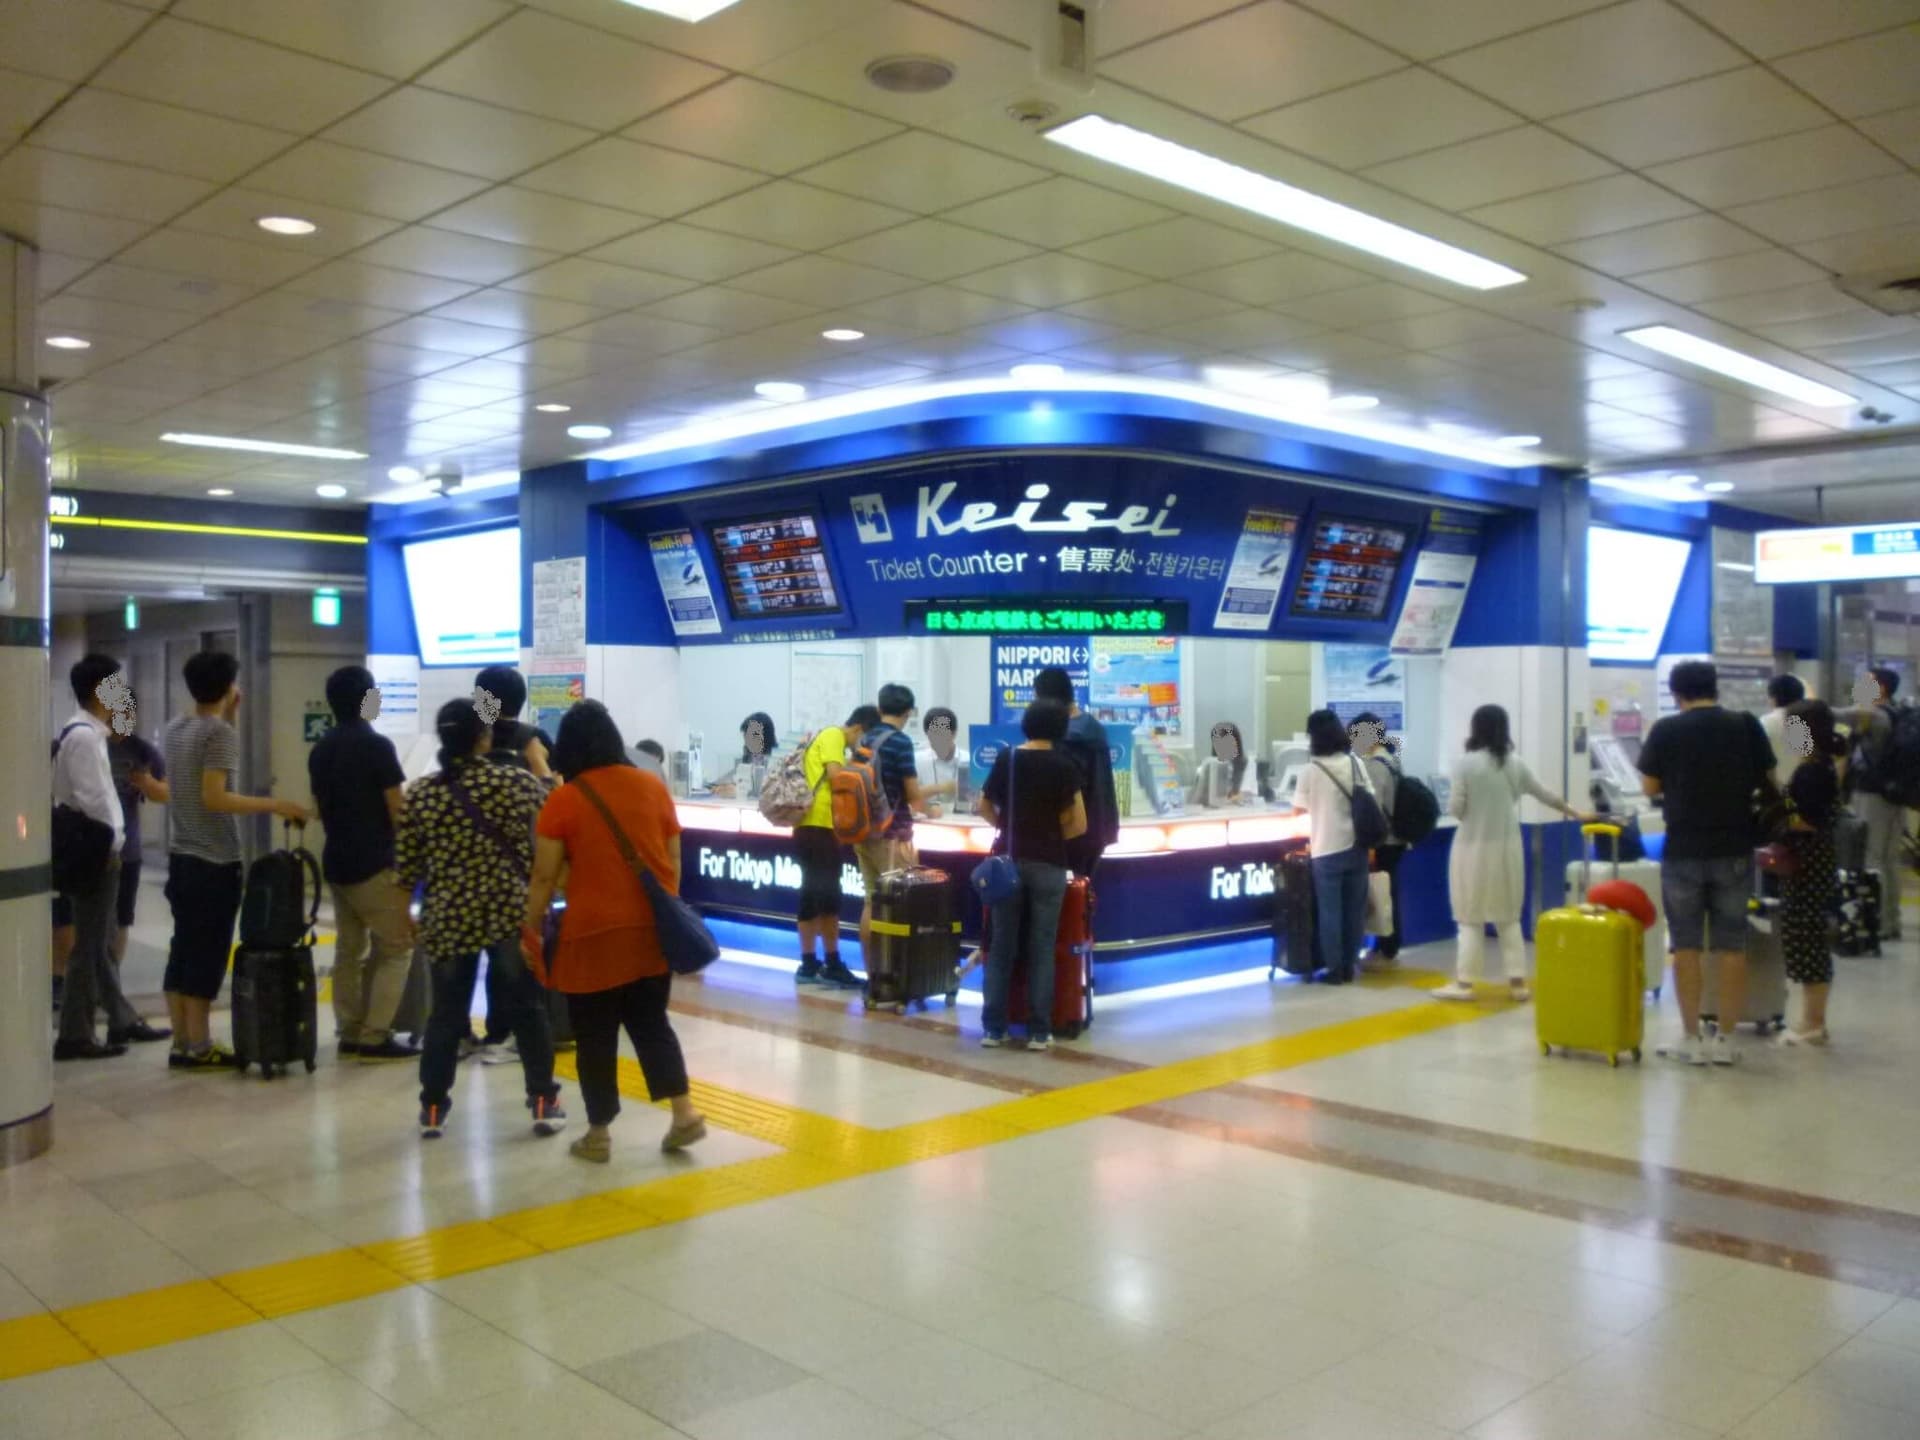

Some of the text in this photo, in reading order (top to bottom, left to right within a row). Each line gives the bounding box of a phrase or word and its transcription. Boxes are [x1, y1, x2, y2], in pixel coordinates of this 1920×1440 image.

[916, 481, 1181, 538] Keisei
[866, 557, 926, 583] Ticket
[928, 550, 1028, 579] Counter
[1057, 546, 1137, 574] 售票处
[998, 646, 1070, 665] NIPPORI
[998, 668, 1040, 687] NAR
[700, 847, 726, 878] For
[726, 849, 774, 890] Tokyo
[1210, 861, 1275, 900] For Tok
